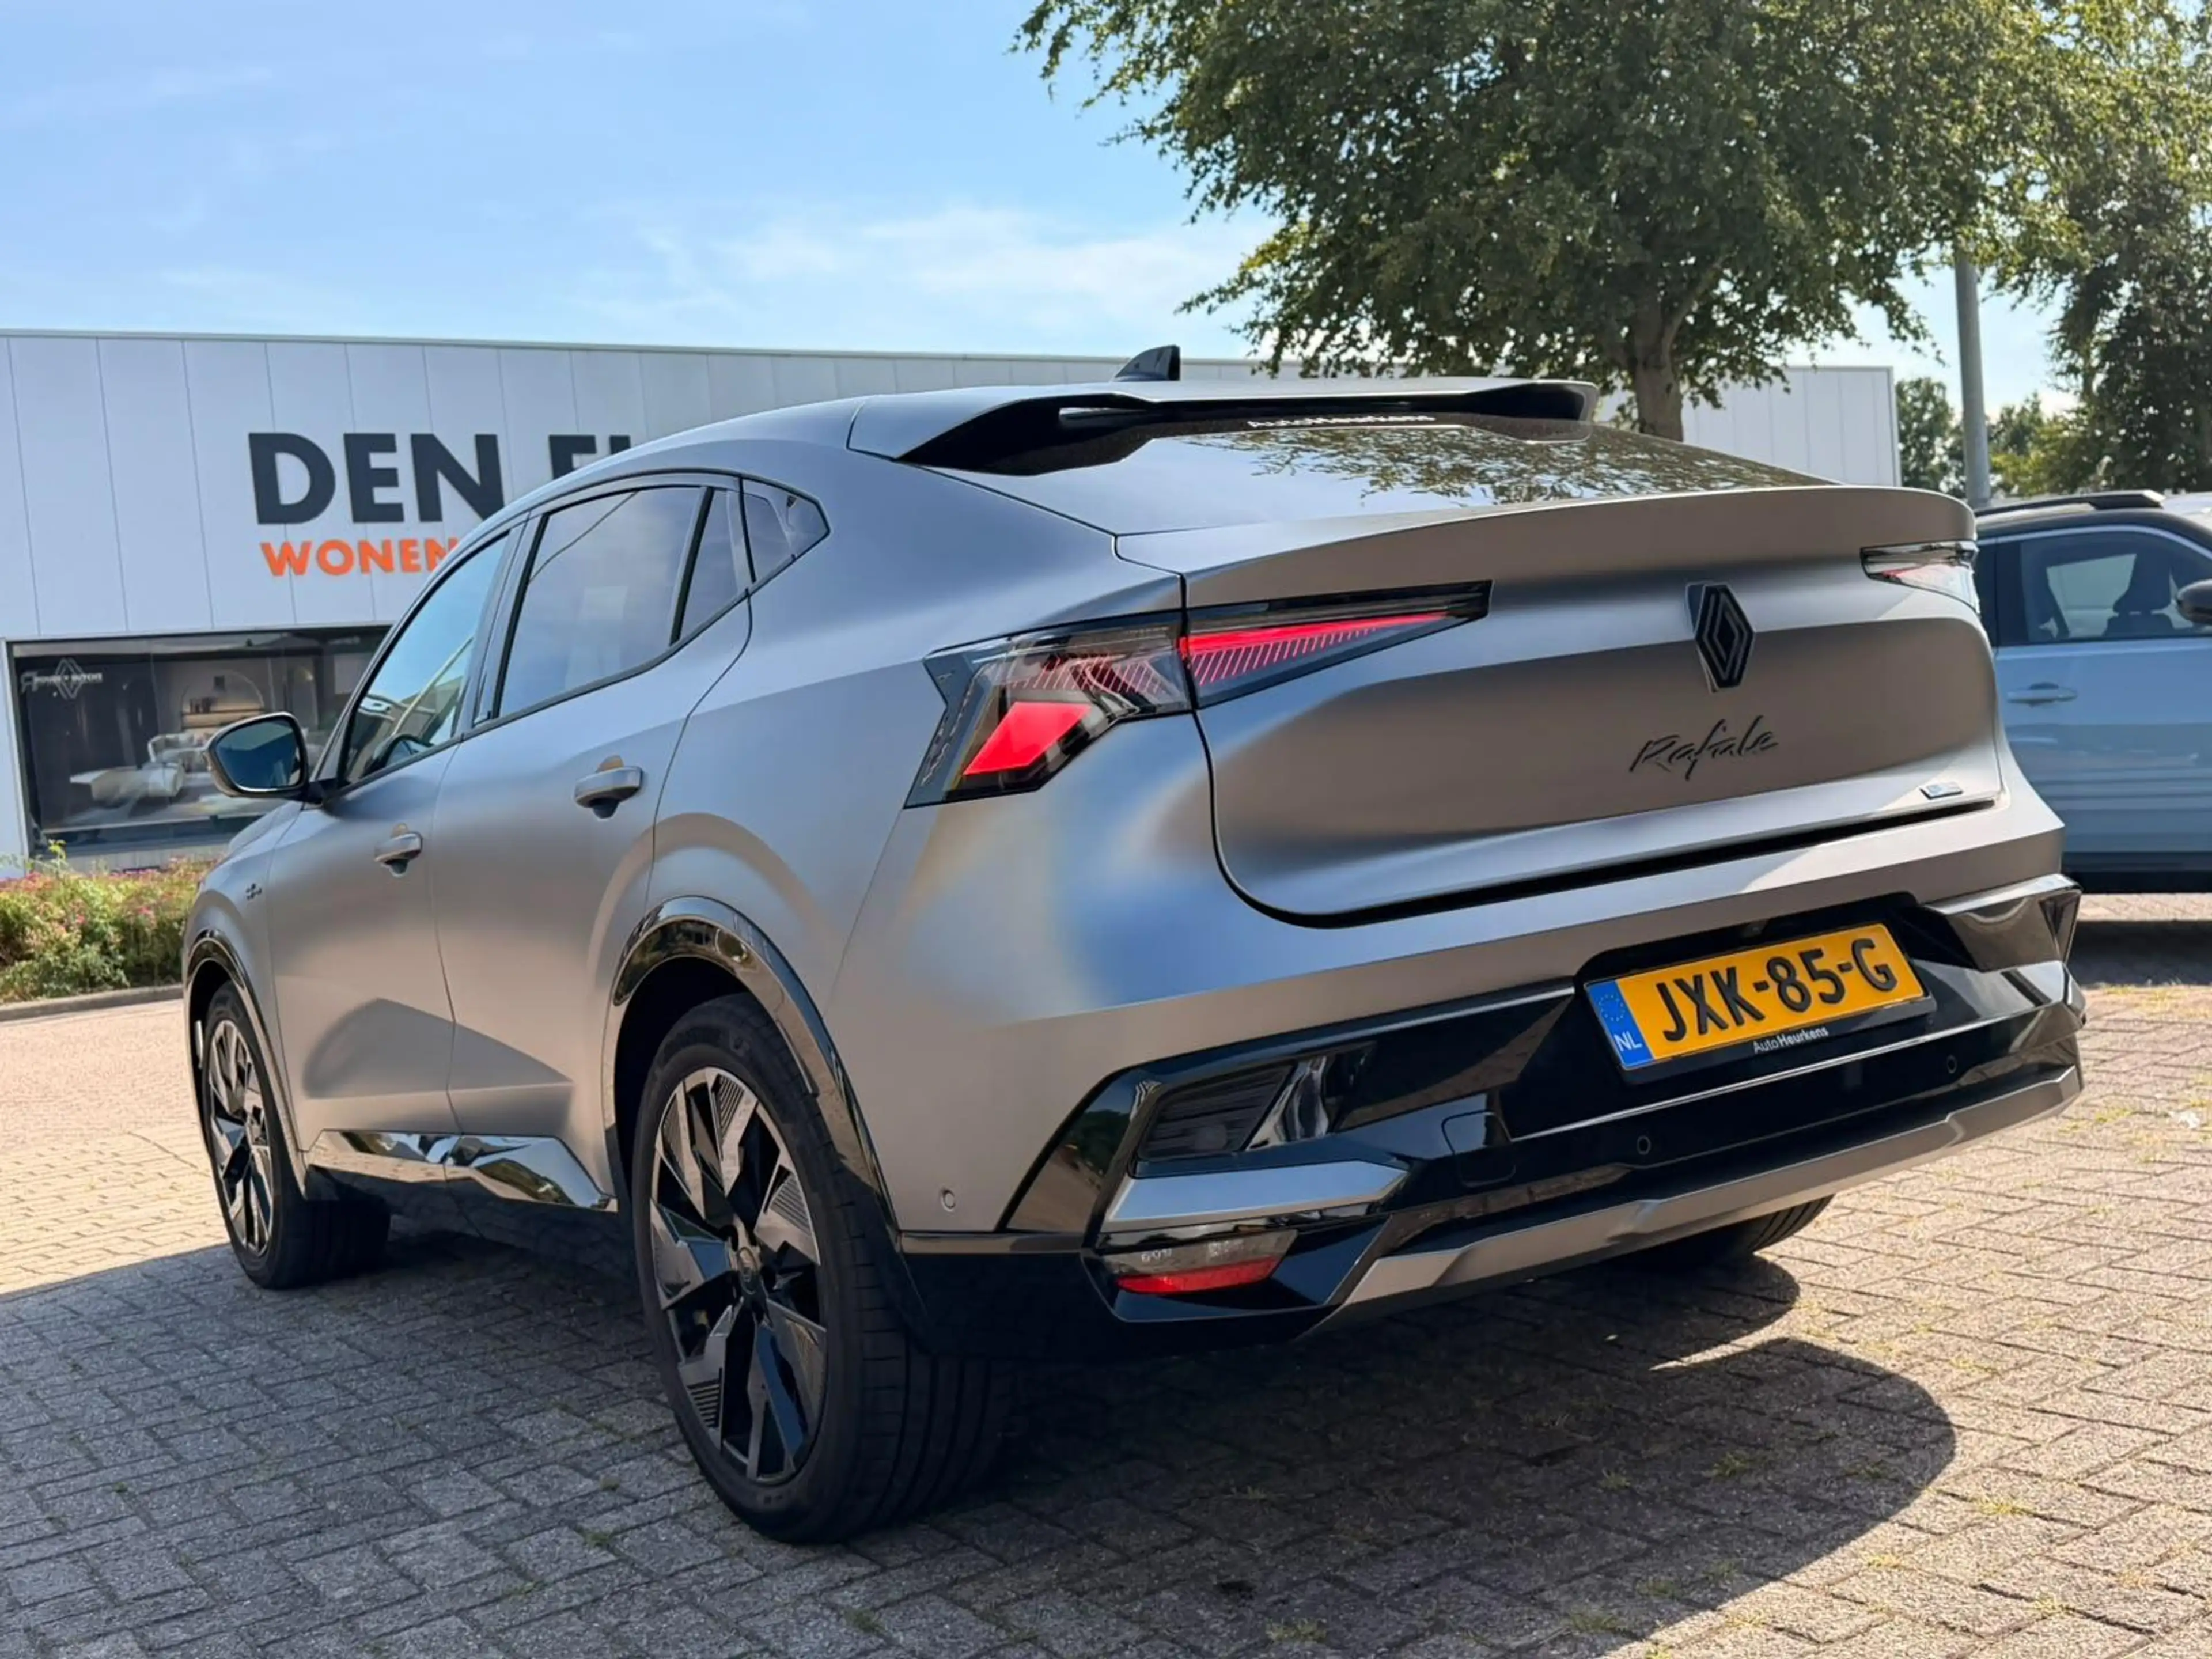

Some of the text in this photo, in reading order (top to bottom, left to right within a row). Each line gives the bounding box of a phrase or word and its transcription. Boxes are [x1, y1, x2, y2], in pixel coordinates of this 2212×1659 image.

[248, 433, 506, 525] DEN
[260, 538, 458, 577] WONEN
[1630, 715, 1779, 781] Rafale
[1656, 938, 1898, 1041] JXK-85-G
[1613, 1030, 1643, 1051] NL
